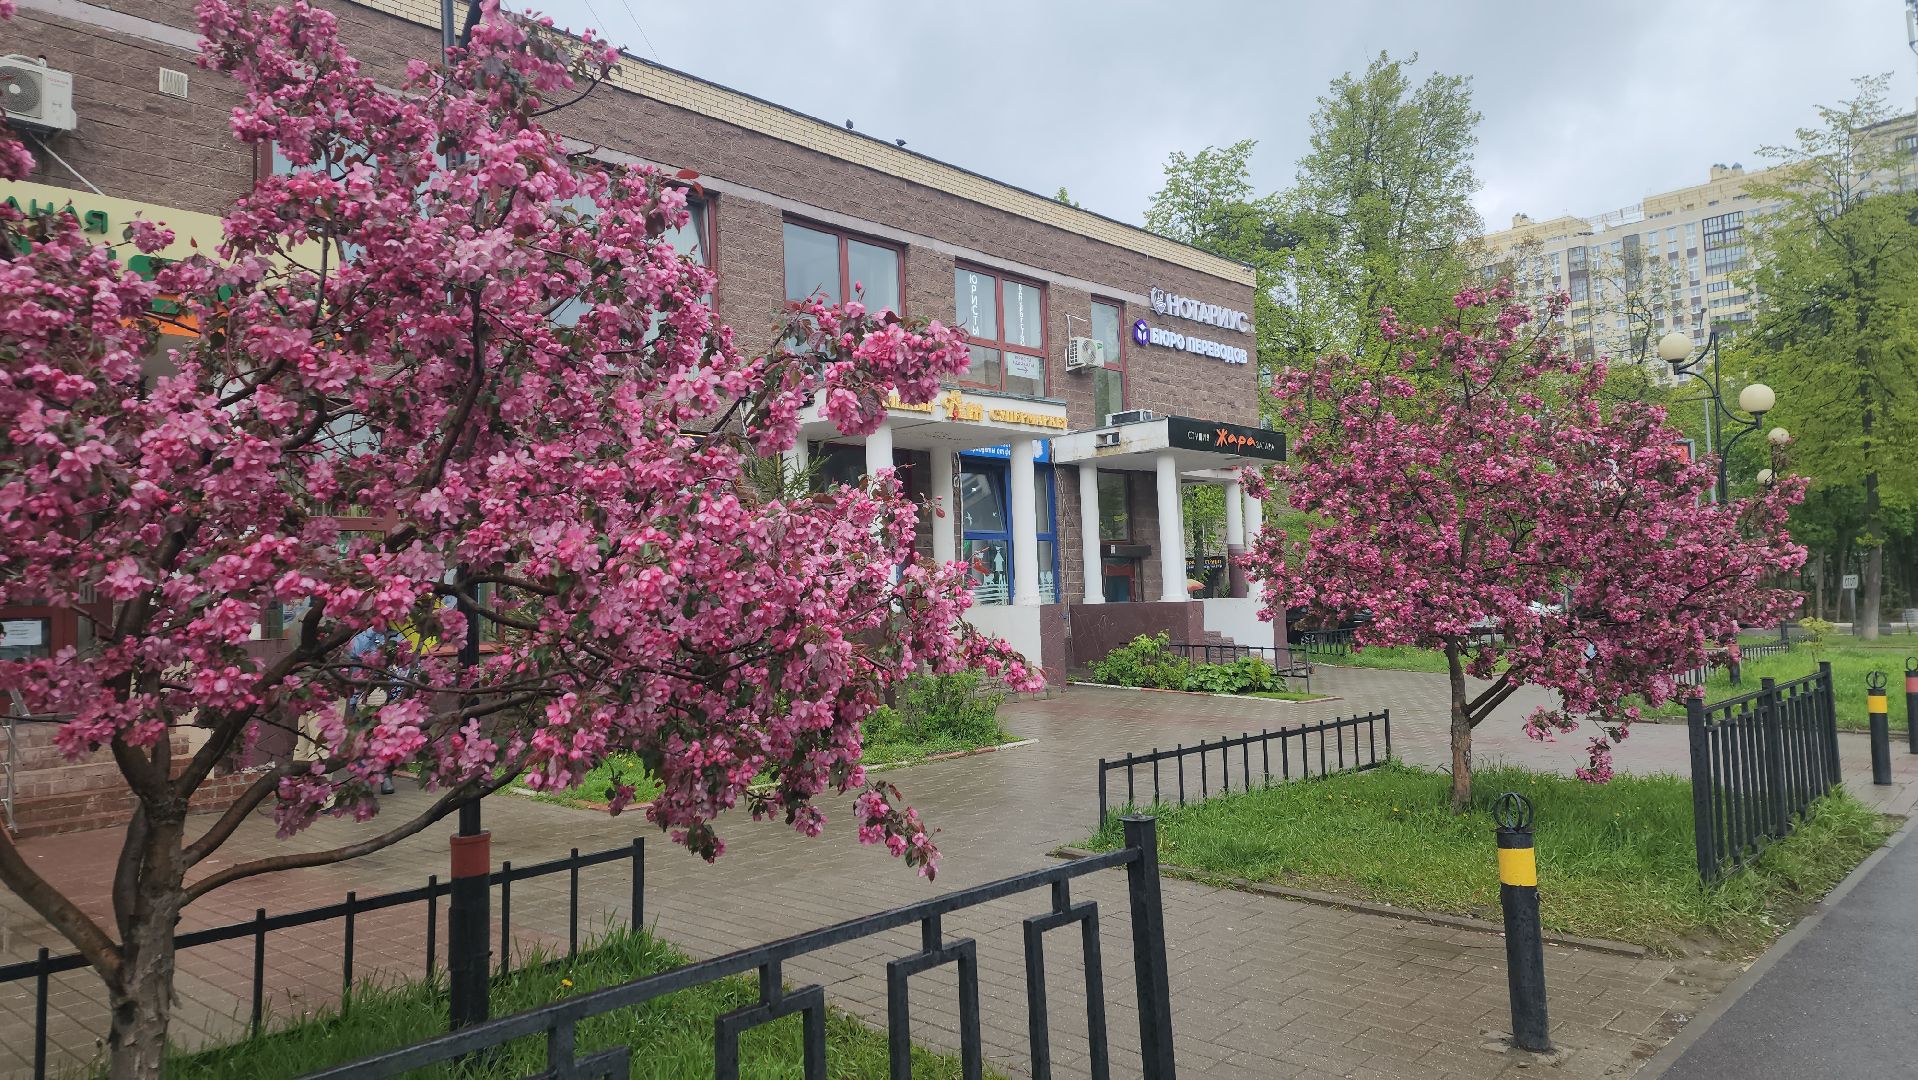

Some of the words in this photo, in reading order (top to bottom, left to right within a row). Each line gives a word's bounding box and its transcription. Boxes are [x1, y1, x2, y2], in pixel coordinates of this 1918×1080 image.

[969, 274, 979, 335] ЮРИСТЫ
[1166, 293, 1248, 333] НОТАРИУС
[1150, 327, 1186, 350] БЮРО
[1186, 336, 1248, 364] ПЕРЕВОДОВ
